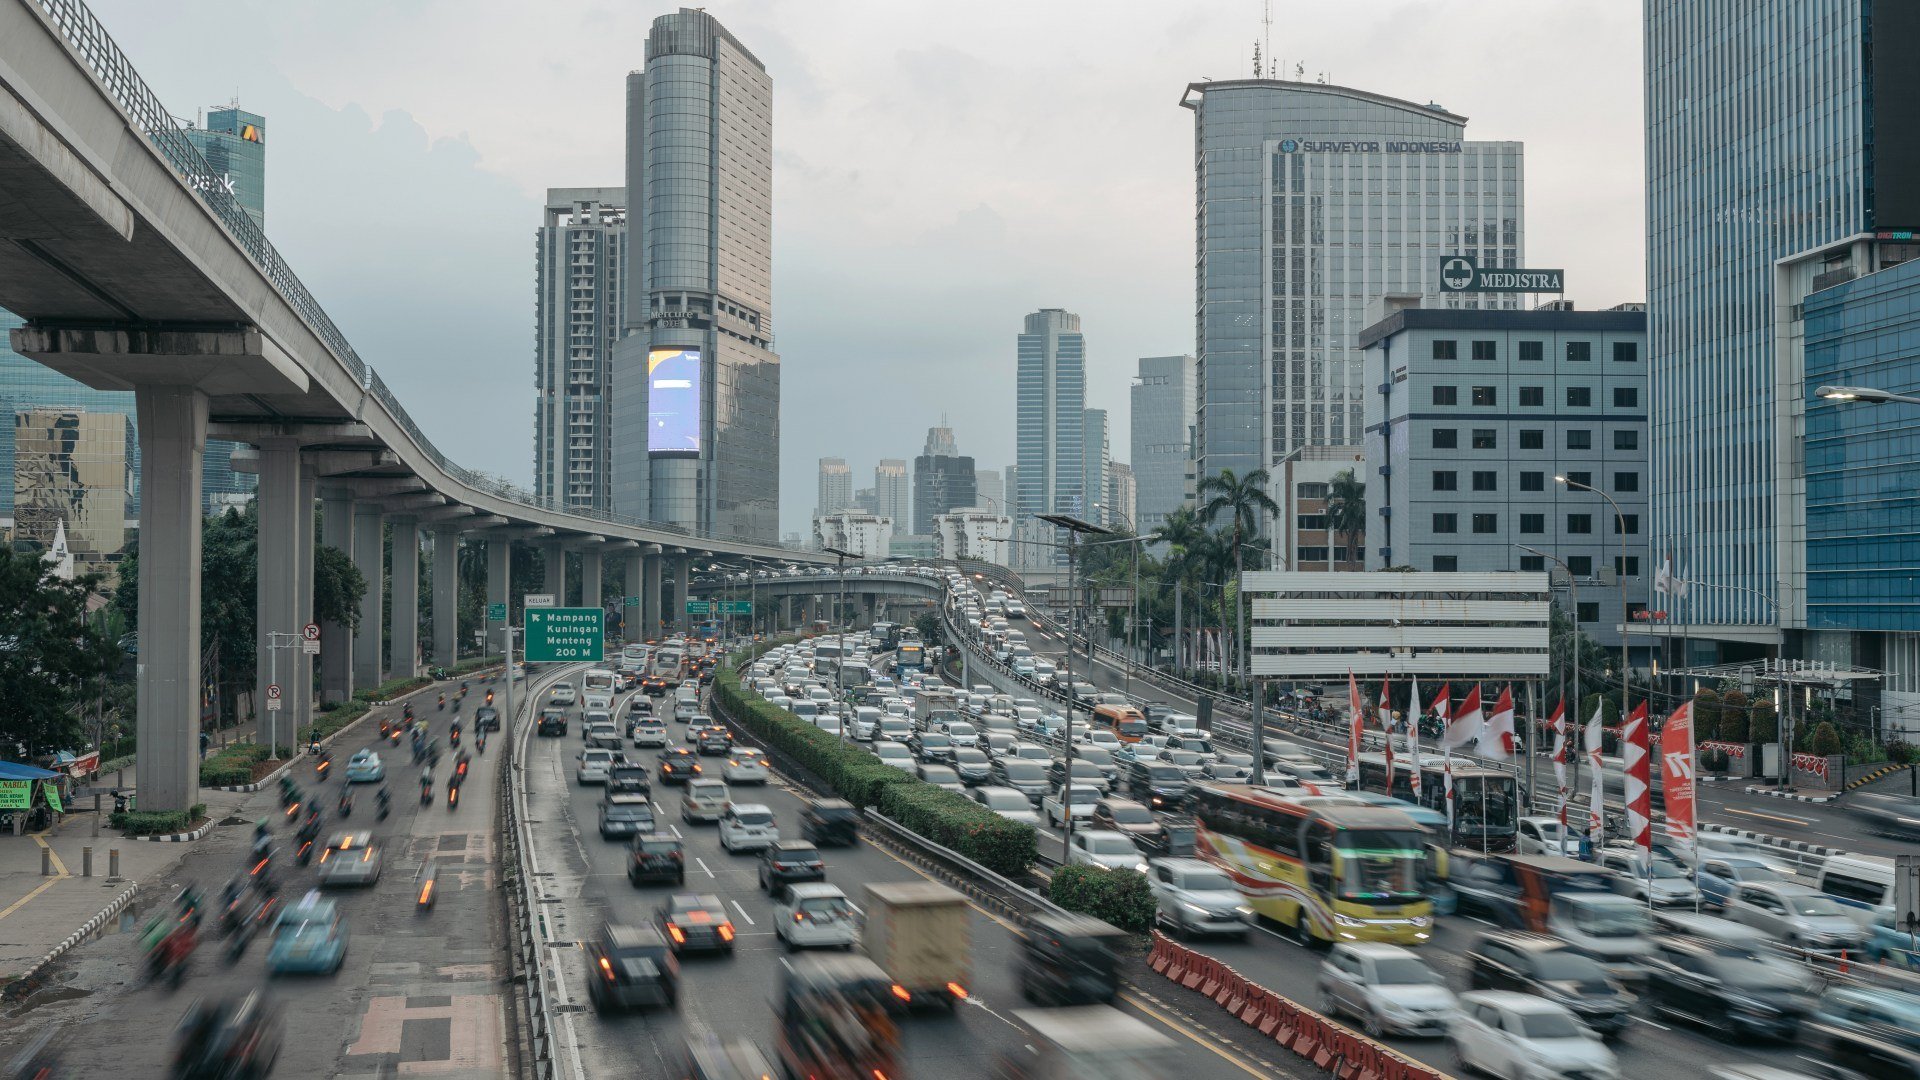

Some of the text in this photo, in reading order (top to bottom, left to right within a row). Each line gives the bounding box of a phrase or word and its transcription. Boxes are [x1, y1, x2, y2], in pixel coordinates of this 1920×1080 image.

[1303, 141, 1462, 153] SURVEYOR INDONESIA
[1480, 273, 1560, 288] MEDISTRA
[651, 311, 693, 319] Mercure
[547, 613, 597, 623] Mampang
[547, 625, 598, 635] Kuningan
[547, 636, 592, 646] Menteng
[555, 648, 591, 656] 200 M
